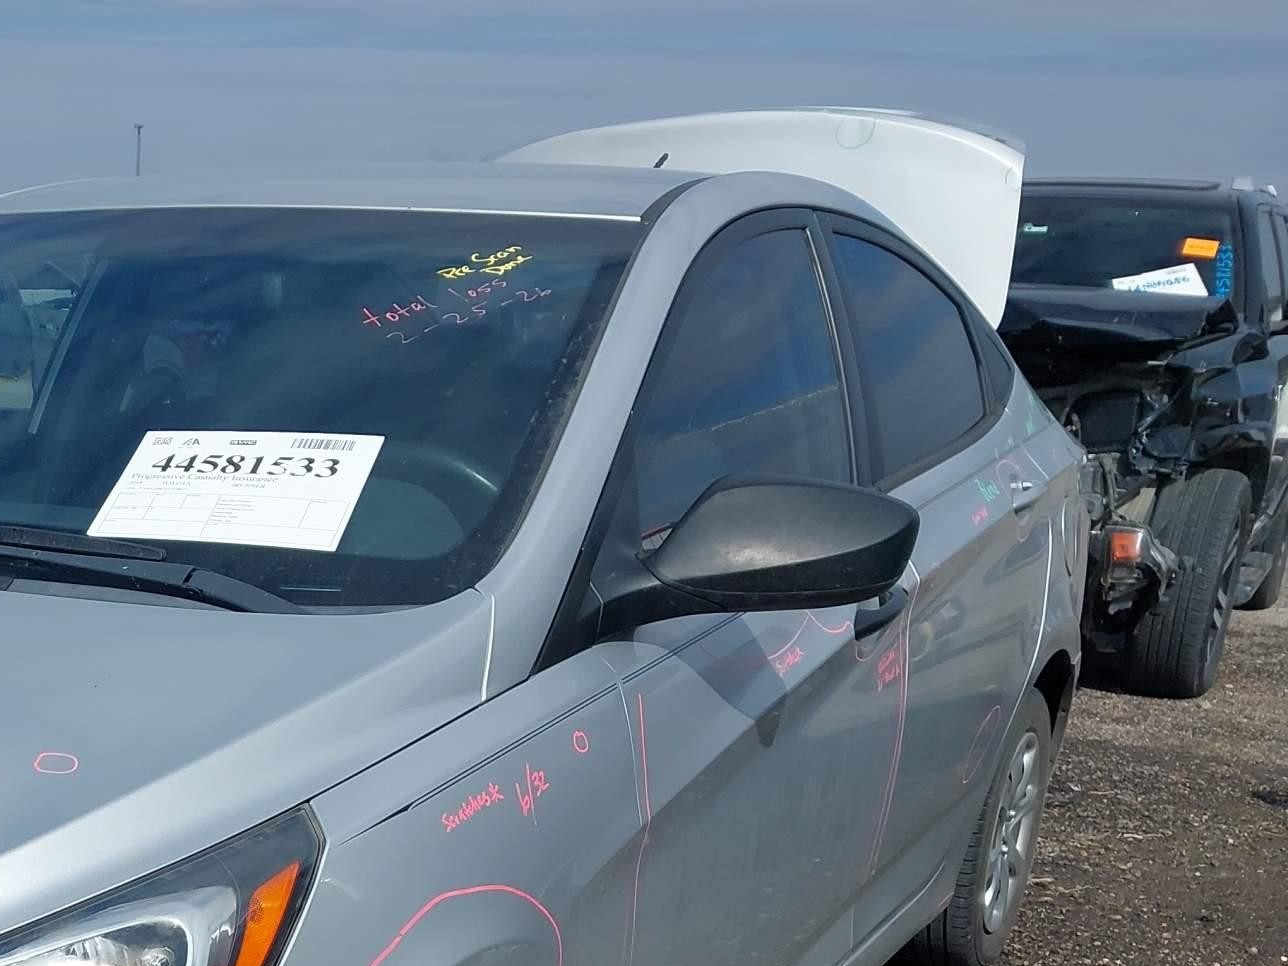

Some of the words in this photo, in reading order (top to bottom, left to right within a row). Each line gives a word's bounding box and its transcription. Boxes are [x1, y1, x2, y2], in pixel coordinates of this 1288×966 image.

[362, 294, 440, 328] total
[447, 278, 508, 303] loss
[151, 453, 341, 478] 44581533
